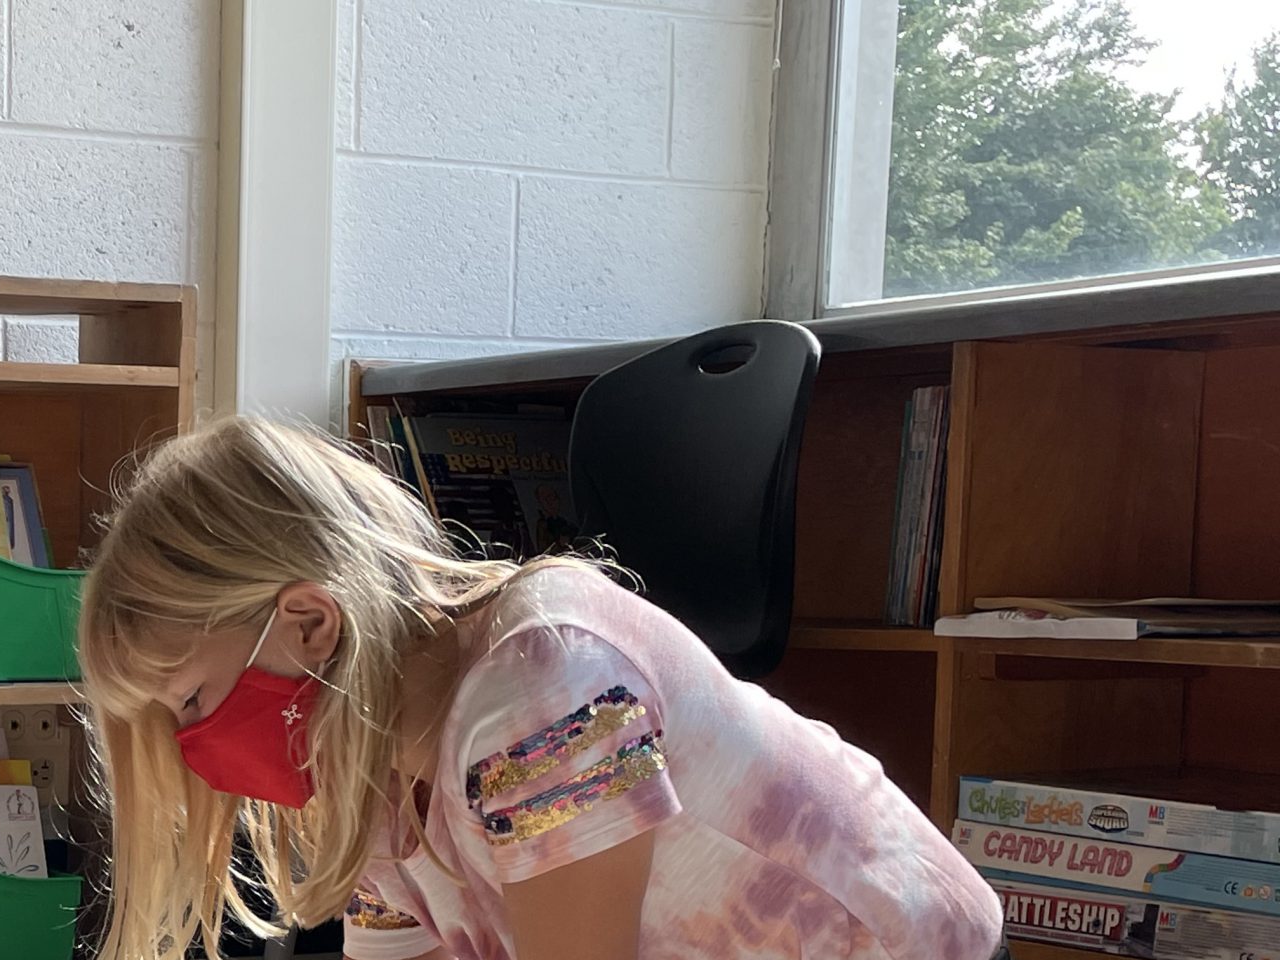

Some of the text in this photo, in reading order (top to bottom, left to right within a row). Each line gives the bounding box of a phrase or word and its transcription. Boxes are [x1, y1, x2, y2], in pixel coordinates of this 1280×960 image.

[446, 427, 517, 453] Being
[1148, 805, 1166, 819] MB
[984, 830, 1064, 866] CANDY
[1067, 843, 1133, 877] LAND
[1159, 911, 1176, 926] MB
